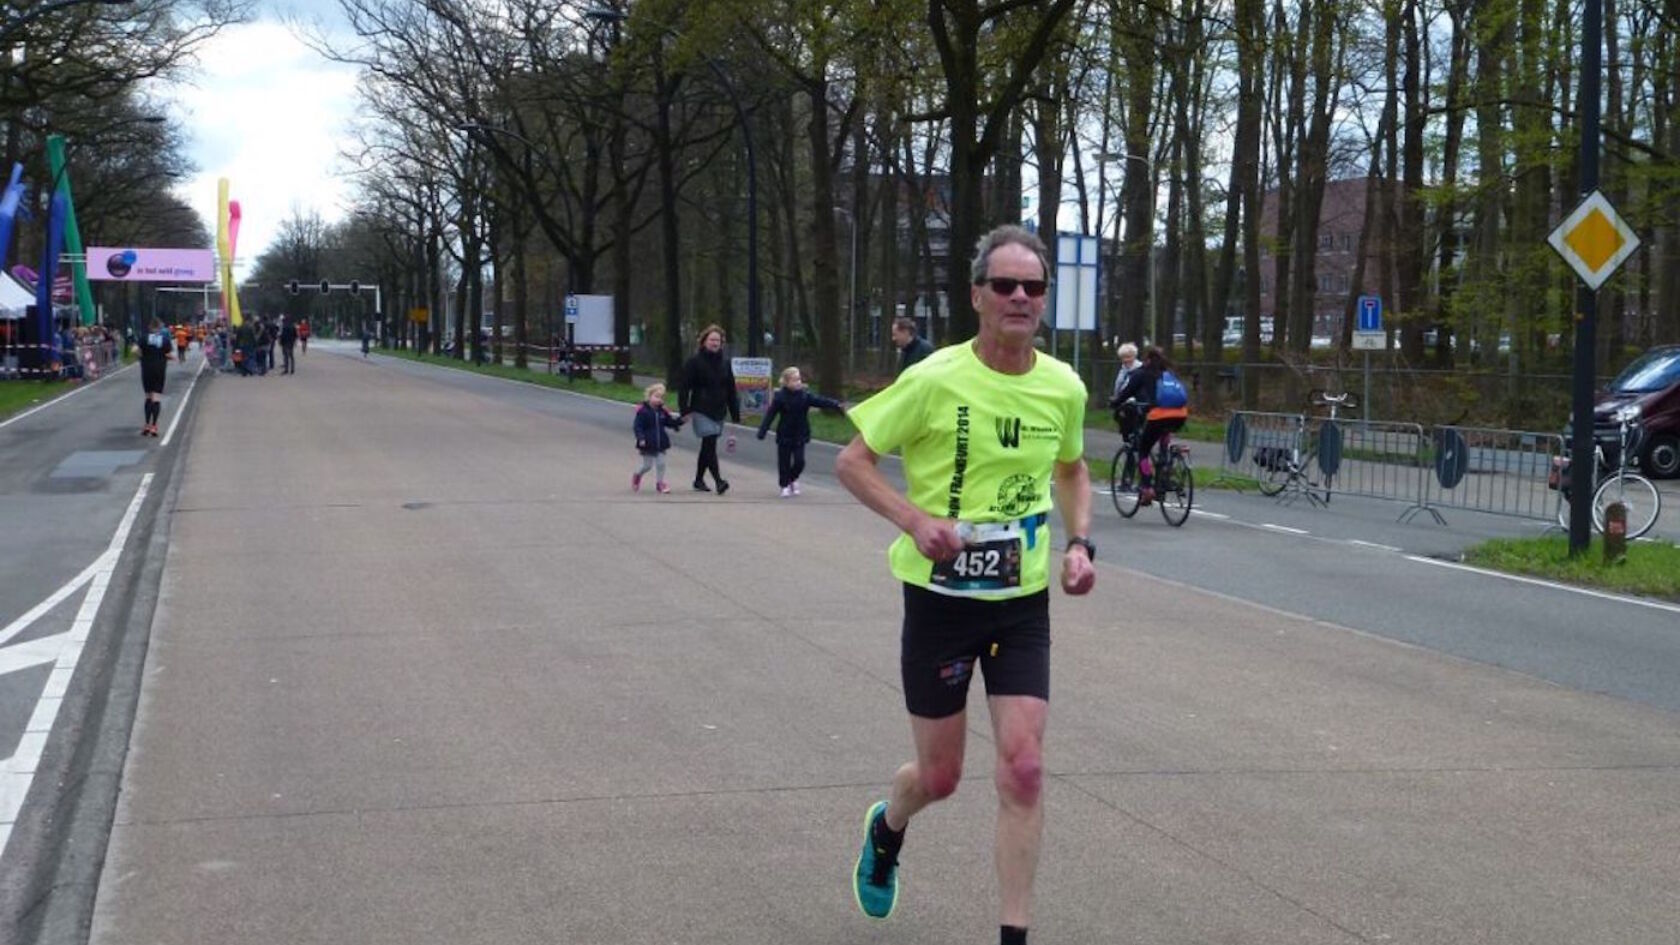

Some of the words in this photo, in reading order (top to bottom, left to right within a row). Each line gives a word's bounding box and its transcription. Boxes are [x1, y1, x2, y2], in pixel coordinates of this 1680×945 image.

[957, 406, 969, 434] 2014
[949, 437, 969, 494] FRANKFURT
[953, 549, 1001, 577] 452
